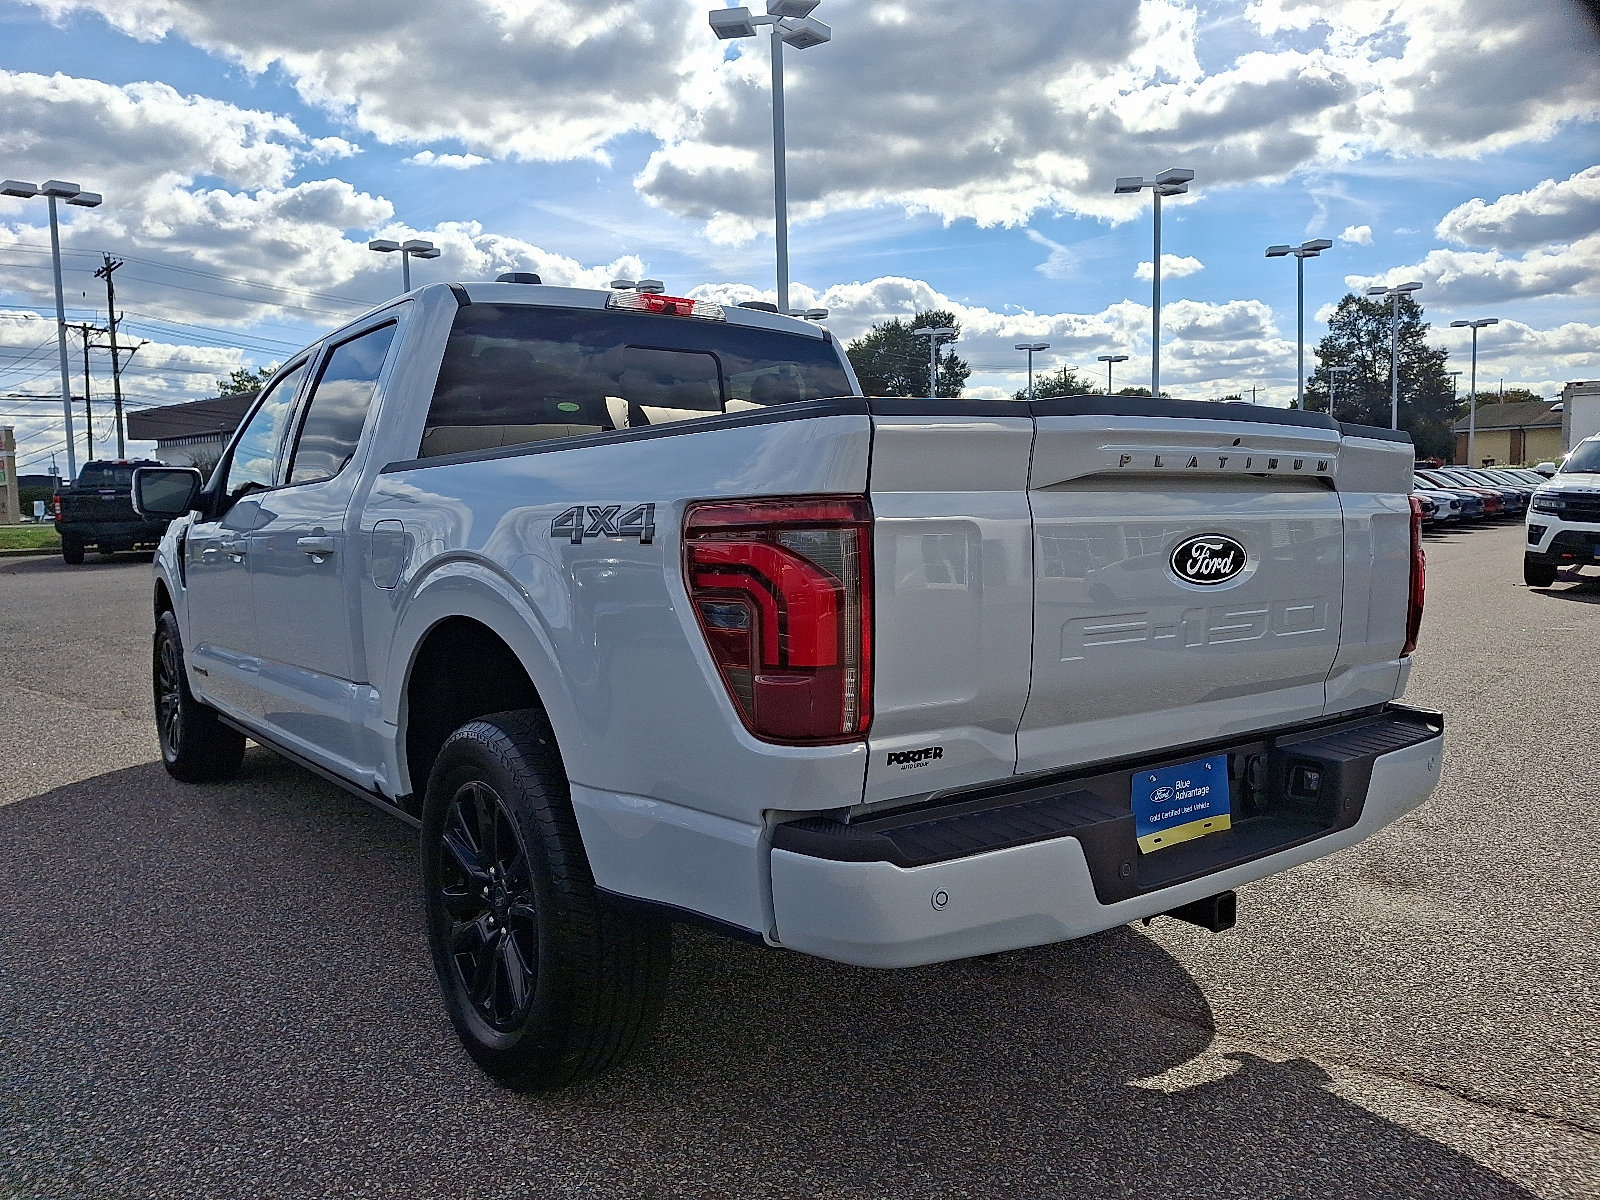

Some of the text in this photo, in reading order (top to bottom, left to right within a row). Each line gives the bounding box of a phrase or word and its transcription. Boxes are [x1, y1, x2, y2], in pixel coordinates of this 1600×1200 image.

[1119, 454, 1328, 472] PLATINUM
[1186, 542, 1235, 575] Ford
[1060, 600, 1329, 661] F-150
[886, 746, 944, 766] PORTER
[1175, 780, 1191, 790] Blue
[1175, 786, 1210, 800] Advantage
[1150, 802, 1209, 822] Gold Certified Used Vehicle
